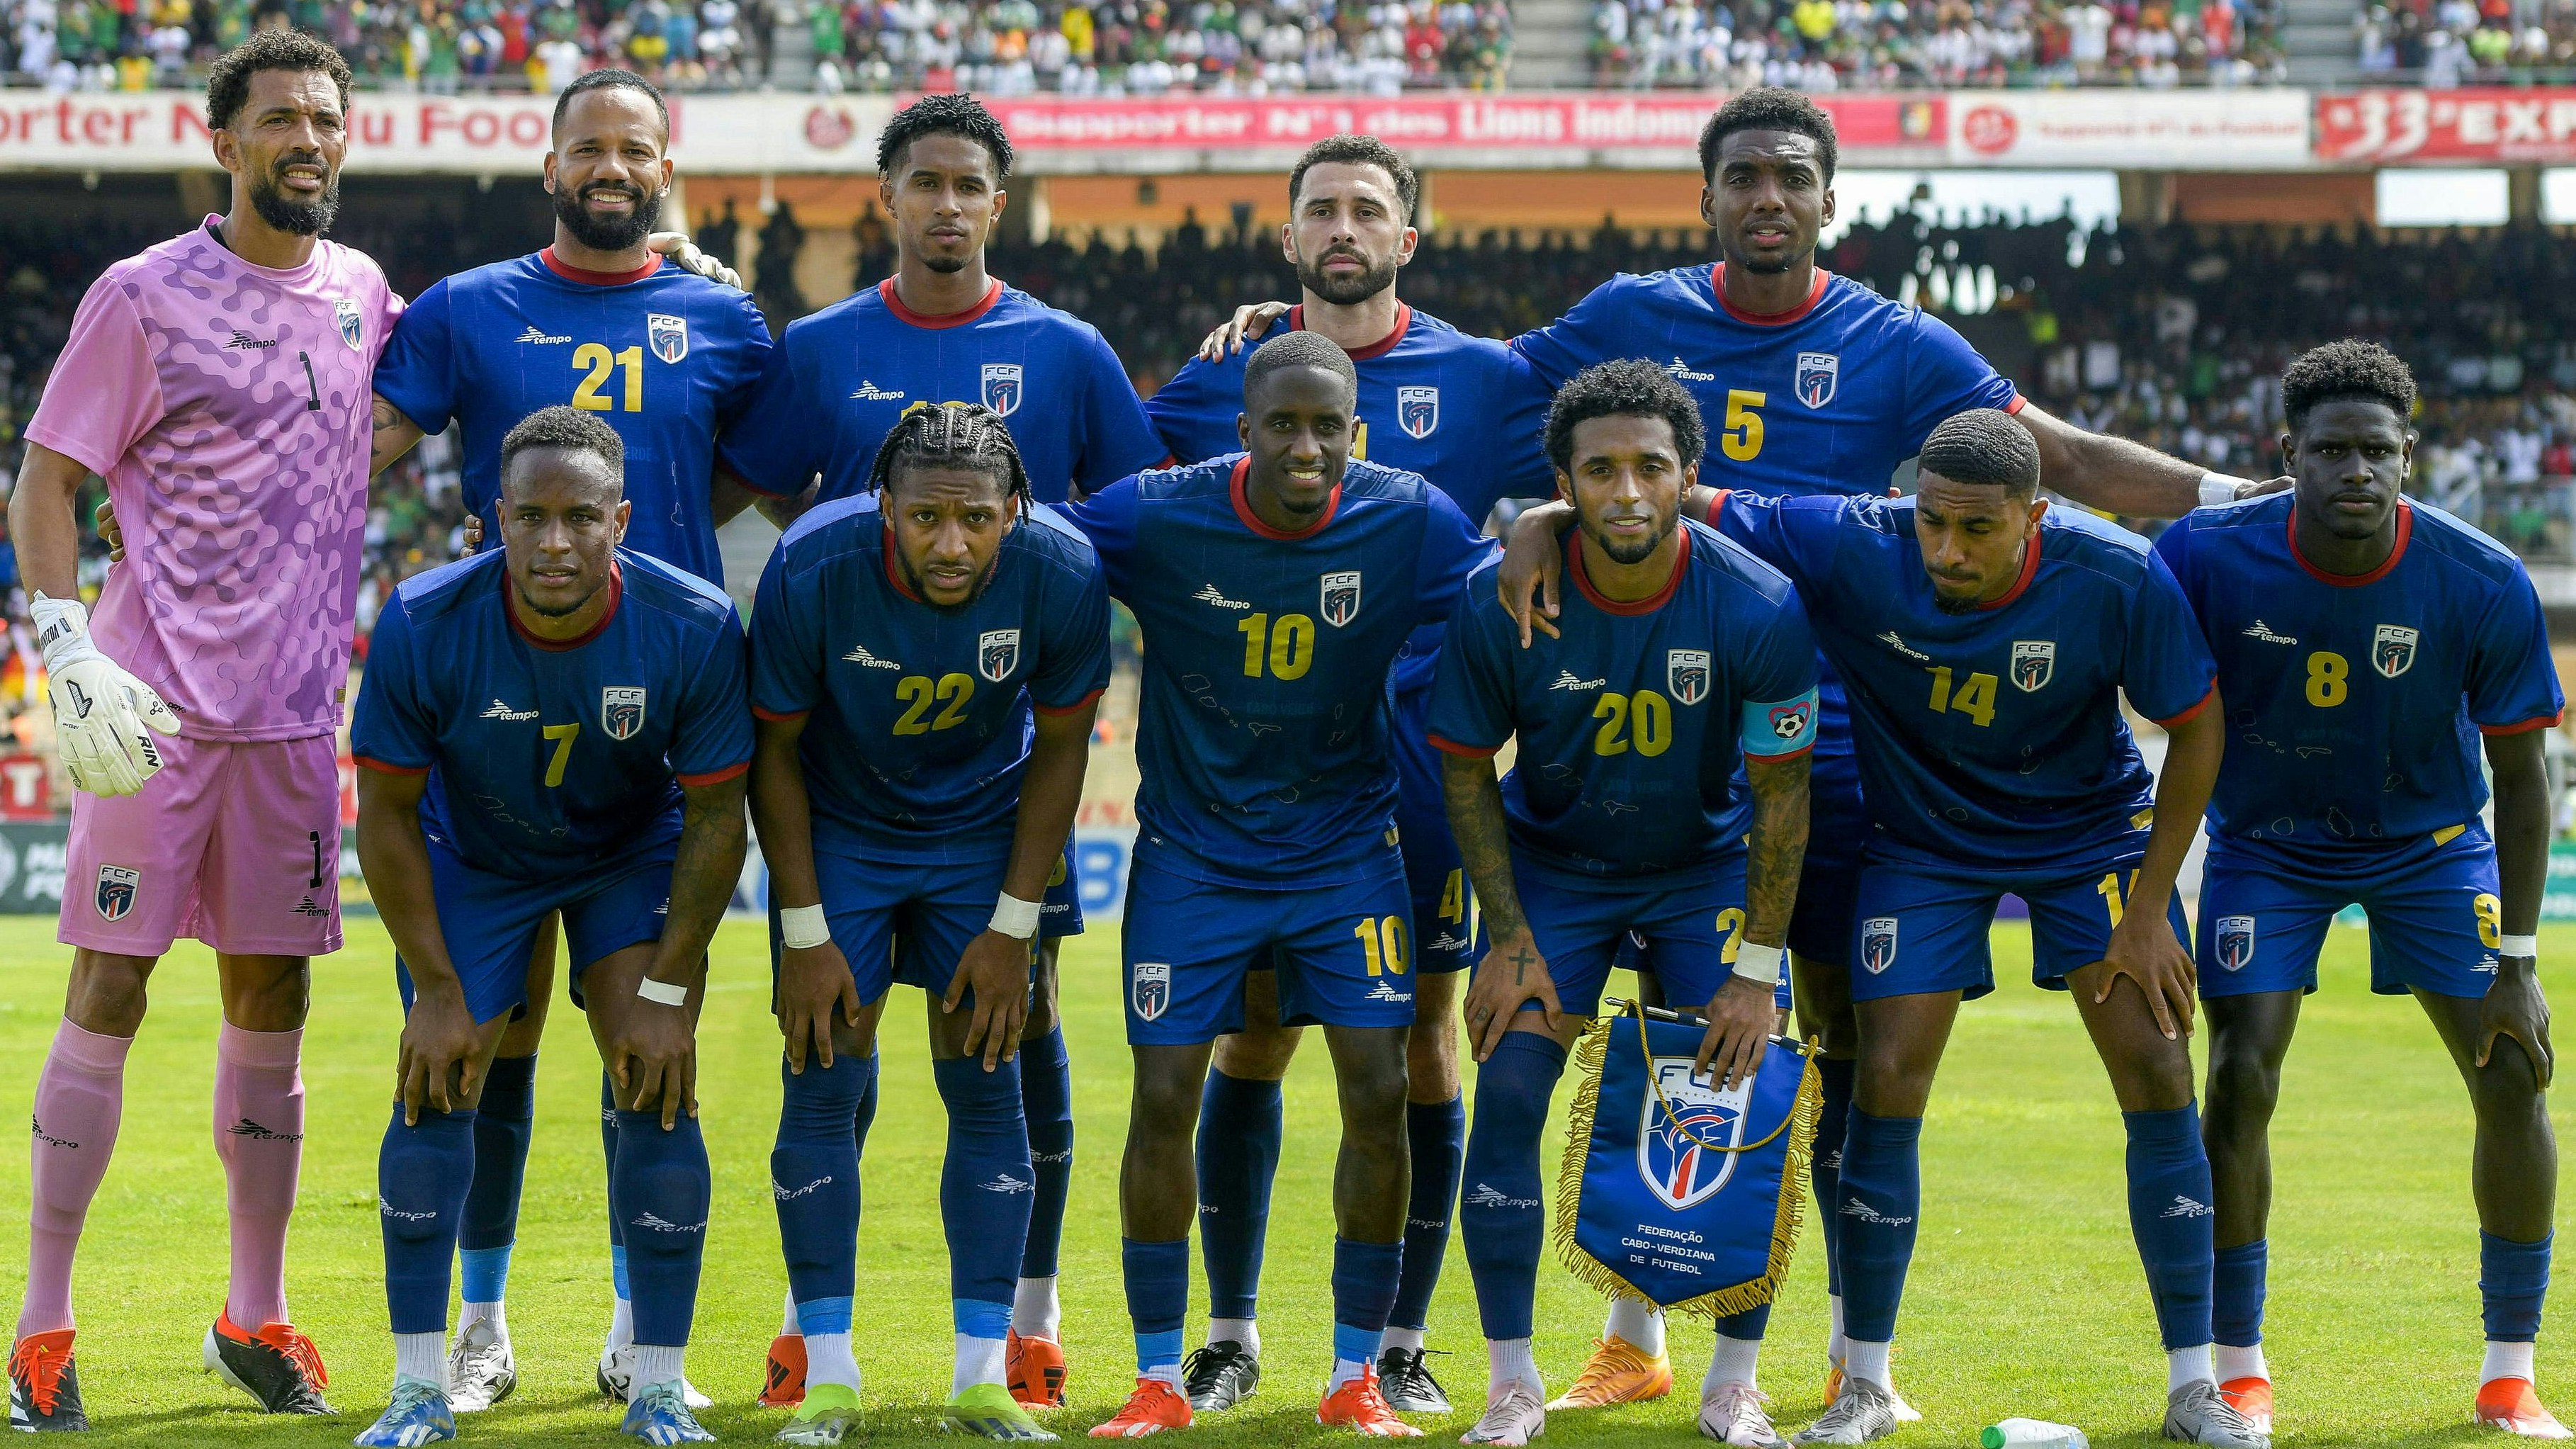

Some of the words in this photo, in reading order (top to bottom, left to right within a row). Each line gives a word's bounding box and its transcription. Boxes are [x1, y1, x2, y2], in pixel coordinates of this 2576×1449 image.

[1574, 100, 1710, 140] Indom
[650, 317, 682, 327] FCF
[241, 339, 276, 351] tempo
[533, 334, 572, 345] tempo
[1800, 356, 1835, 366] FCF
[572, 342, 643, 412] 21
[984, 366, 1019, 376] FCF
[1678, 370, 1715, 383] tempo
[299, 350, 321, 411] 1
[867, 390, 905, 401] tempo
[1401, 389, 1435, 398] FCF
[1722, 389, 1767, 461] 5
[1323, 575, 1357, 586] FCF
[1211, 597, 1251, 610] tempo
[982, 631, 1017, 644] FCF
[2260, 632, 2298, 645] tempo
[2378, 627, 2415, 638] FCF
[1238, 612, 1315, 681] 10
[1893, 642, 1930, 662] tempo
[2015, 643, 2052, 653] FCF
[862, 658, 901, 671] tempo
[1671, 653, 1707, 663] FCF
[1568, 677, 1607, 692] tempo
[2305, 651, 2349, 707] 8
[606, 690, 642, 700] FCF
[1925, 665, 1999, 728] 14
[892, 672, 975, 736] 22
[499, 709, 539, 721] tempo
[1592, 689, 1673, 757] 20
[137, 735, 159, 767] RIN
[543, 722, 580, 788] 7
[309, 830, 323, 889] 1
[101, 867, 137, 879] FCF
[1438, 868, 1464, 925] 4
[307, 908, 329, 918] temp
[1040, 904, 1070, 915] empo
[1865, 920, 1893, 931] FCF
[2218, 918, 2252, 929] FCF
[2473, 893, 2502, 949] 8
[1715, 907, 1747, 964] 2
[1354, 915, 1409, 977] 10
[1136, 966, 1168, 976] FCF
[1384, 991, 1412, 1003] tempo
[1488, 1197, 1539, 1210] tempo
[2188, 1205, 2215, 1218] tem
[1860, 1212, 1912, 1227] tempo
[1638, 1224, 1703, 1244] FEDERAÇÃO
[1621, 1237, 1715, 1262] CABO-VERDIANA
[1629, 1254, 1645, 1264] DE
[1651, 1258, 1702, 1275] FUTEBOL
